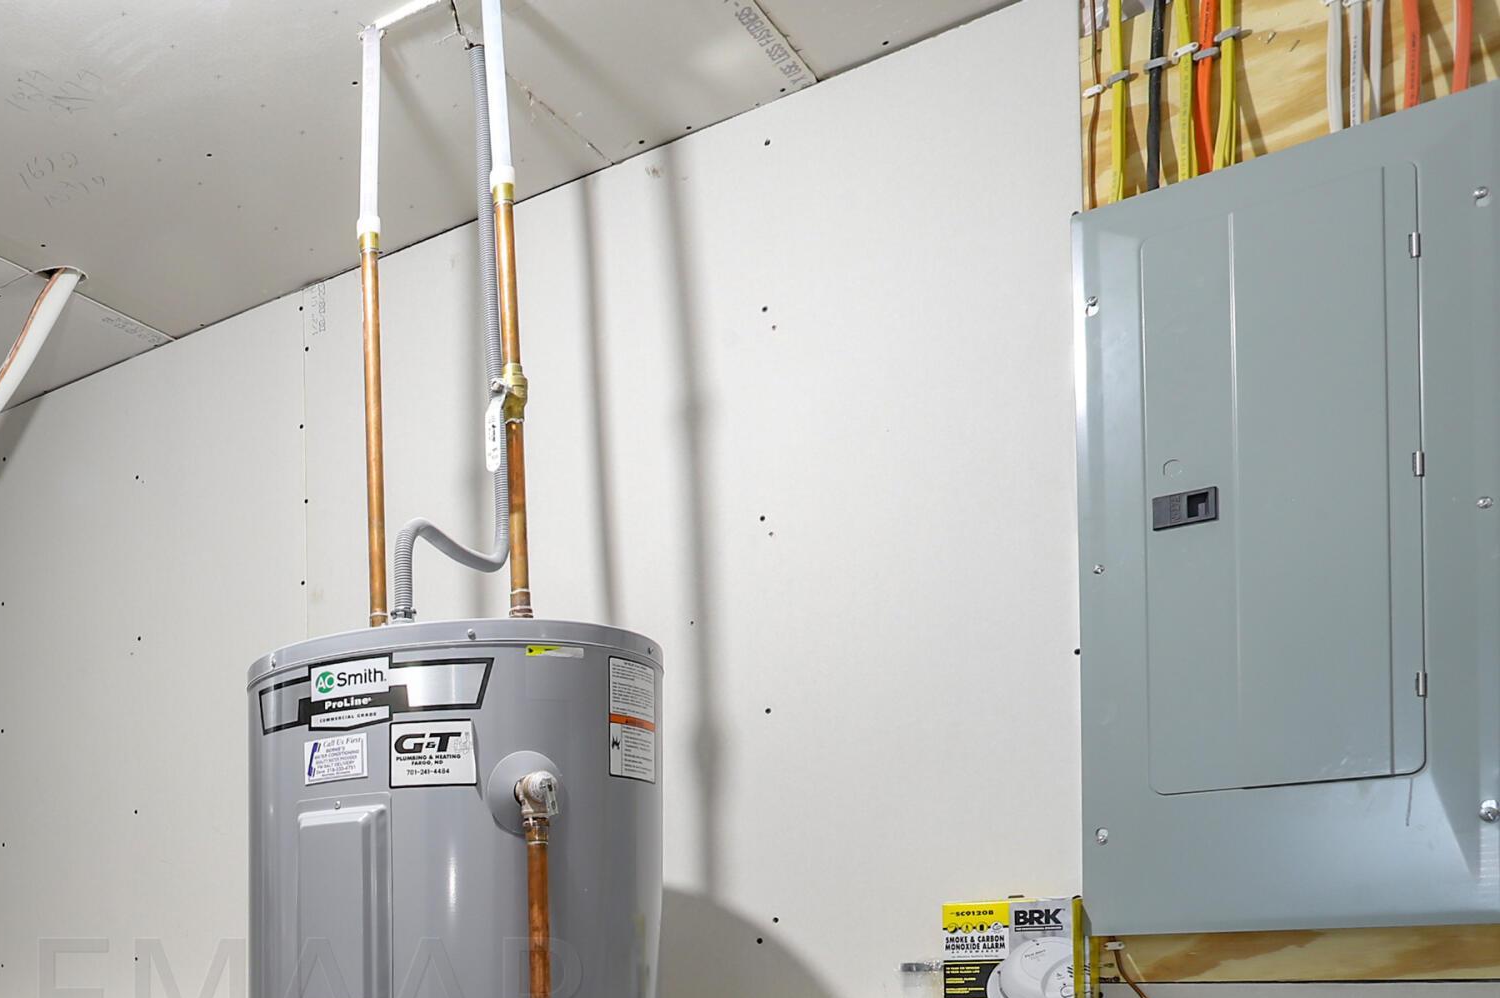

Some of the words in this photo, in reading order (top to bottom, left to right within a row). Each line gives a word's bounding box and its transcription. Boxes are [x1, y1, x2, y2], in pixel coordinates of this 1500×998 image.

[325, 697, 368, 710] ProLine
[394, 732, 461, 754] G&T
[1014, 909, 1062, 925] BRK
[945, 943, 980, 951] MONOXIDE
